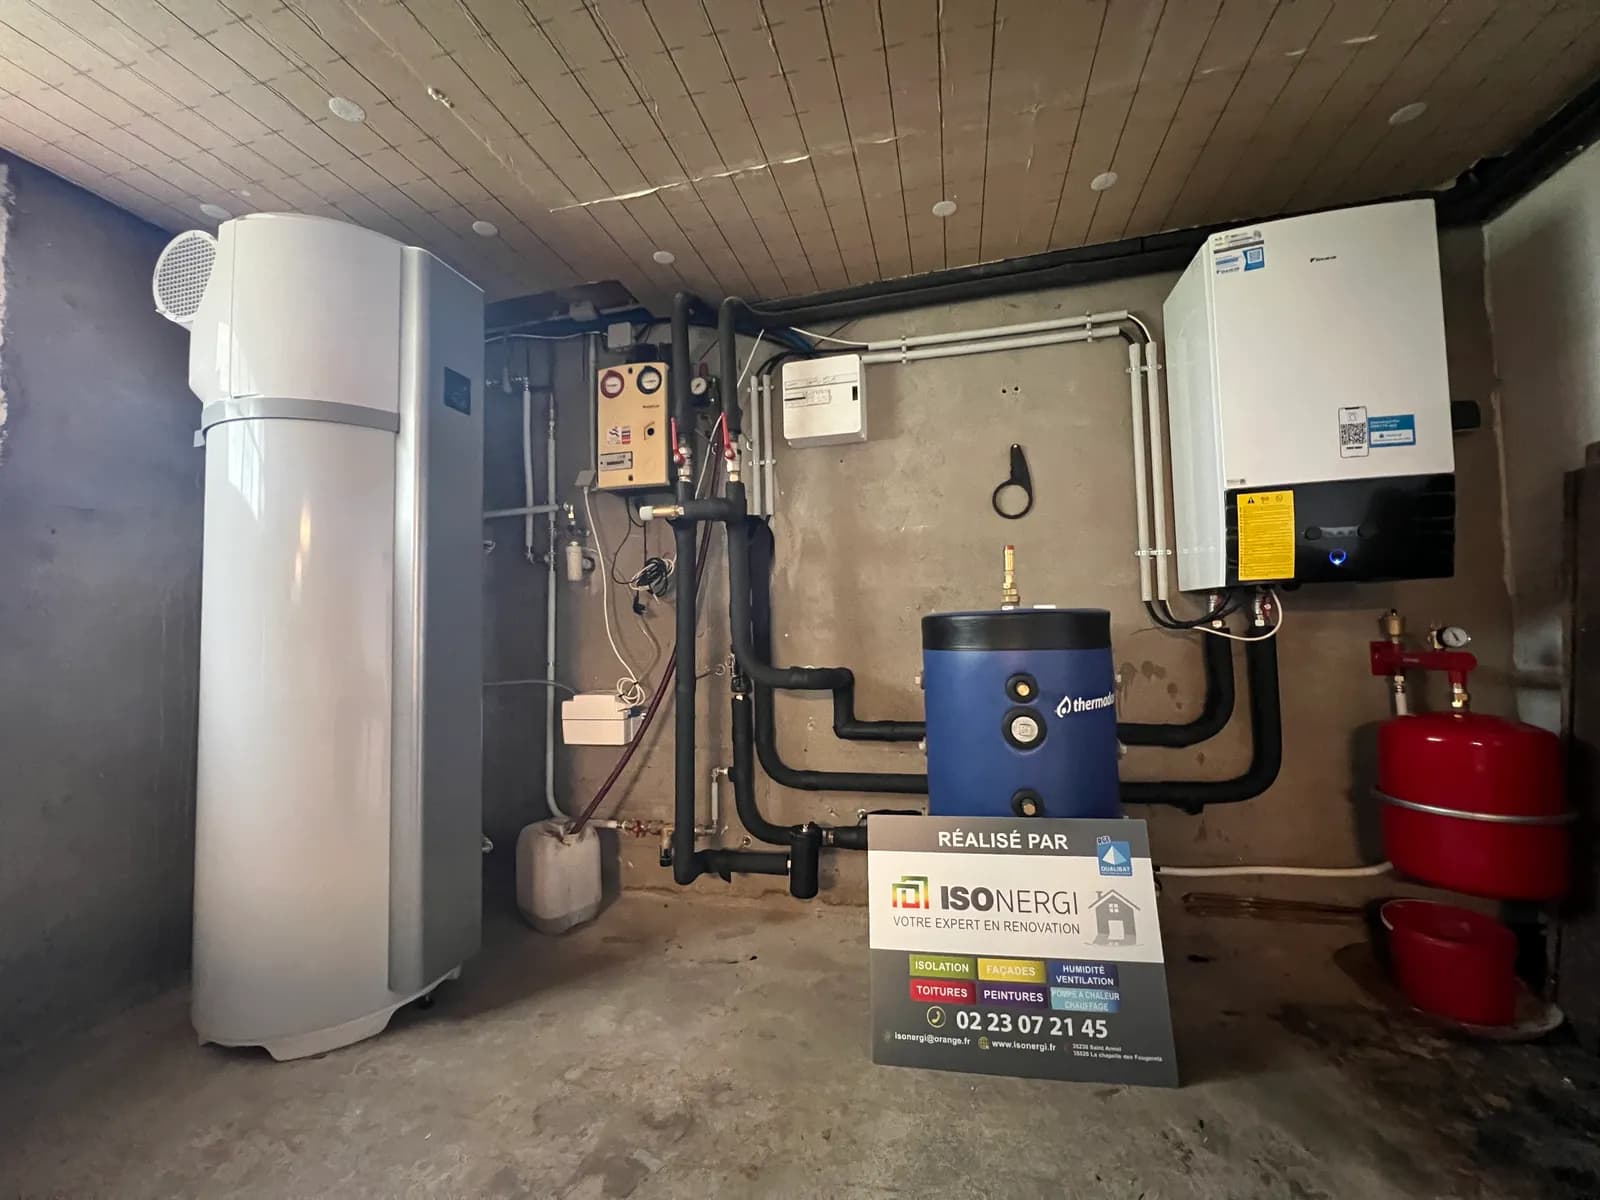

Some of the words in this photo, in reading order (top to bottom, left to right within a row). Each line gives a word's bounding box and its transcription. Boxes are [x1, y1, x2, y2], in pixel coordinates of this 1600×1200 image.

[938, 829, 1021, 848] RÉALISÉ
[1028, 833, 1068, 850] PAR
[940, 885, 1078, 915] ISONERGI
[893, 915, 932, 928] VOTRE
[935, 917, 981, 931] EXPERT
[984, 920, 1000, 931] EN
[1003, 920, 1081, 935] RENOVATION
[914, 960, 970, 974] ISOLATION
[986, 964, 1036, 977] FAÇADES
[1062, 962, 1105, 975] HUMIDITÉ
[1055, 975, 1114, 986] VENTILATION
[915, 984, 968, 999] TOITURES
[983, 989, 1044, 1003] PEINTURES
[1085, 991, 1120, 1001] CHALEUR
[1064, 1001, 1109, 1011] CHAUFFAGE
[956, 1011, 982, 1031] 02
[987, 1013, 1013, 1032] 23
[1018, 1015, 1044, 1034] 07
[1050, 1017, 1073, 1036] 21
[1081, 1019, 1108, 1038] 45
[894, 1032, 971, 1047] isonergi@orange.fr
[991, 1039, 1056, 1052] www.isonergi.fr
